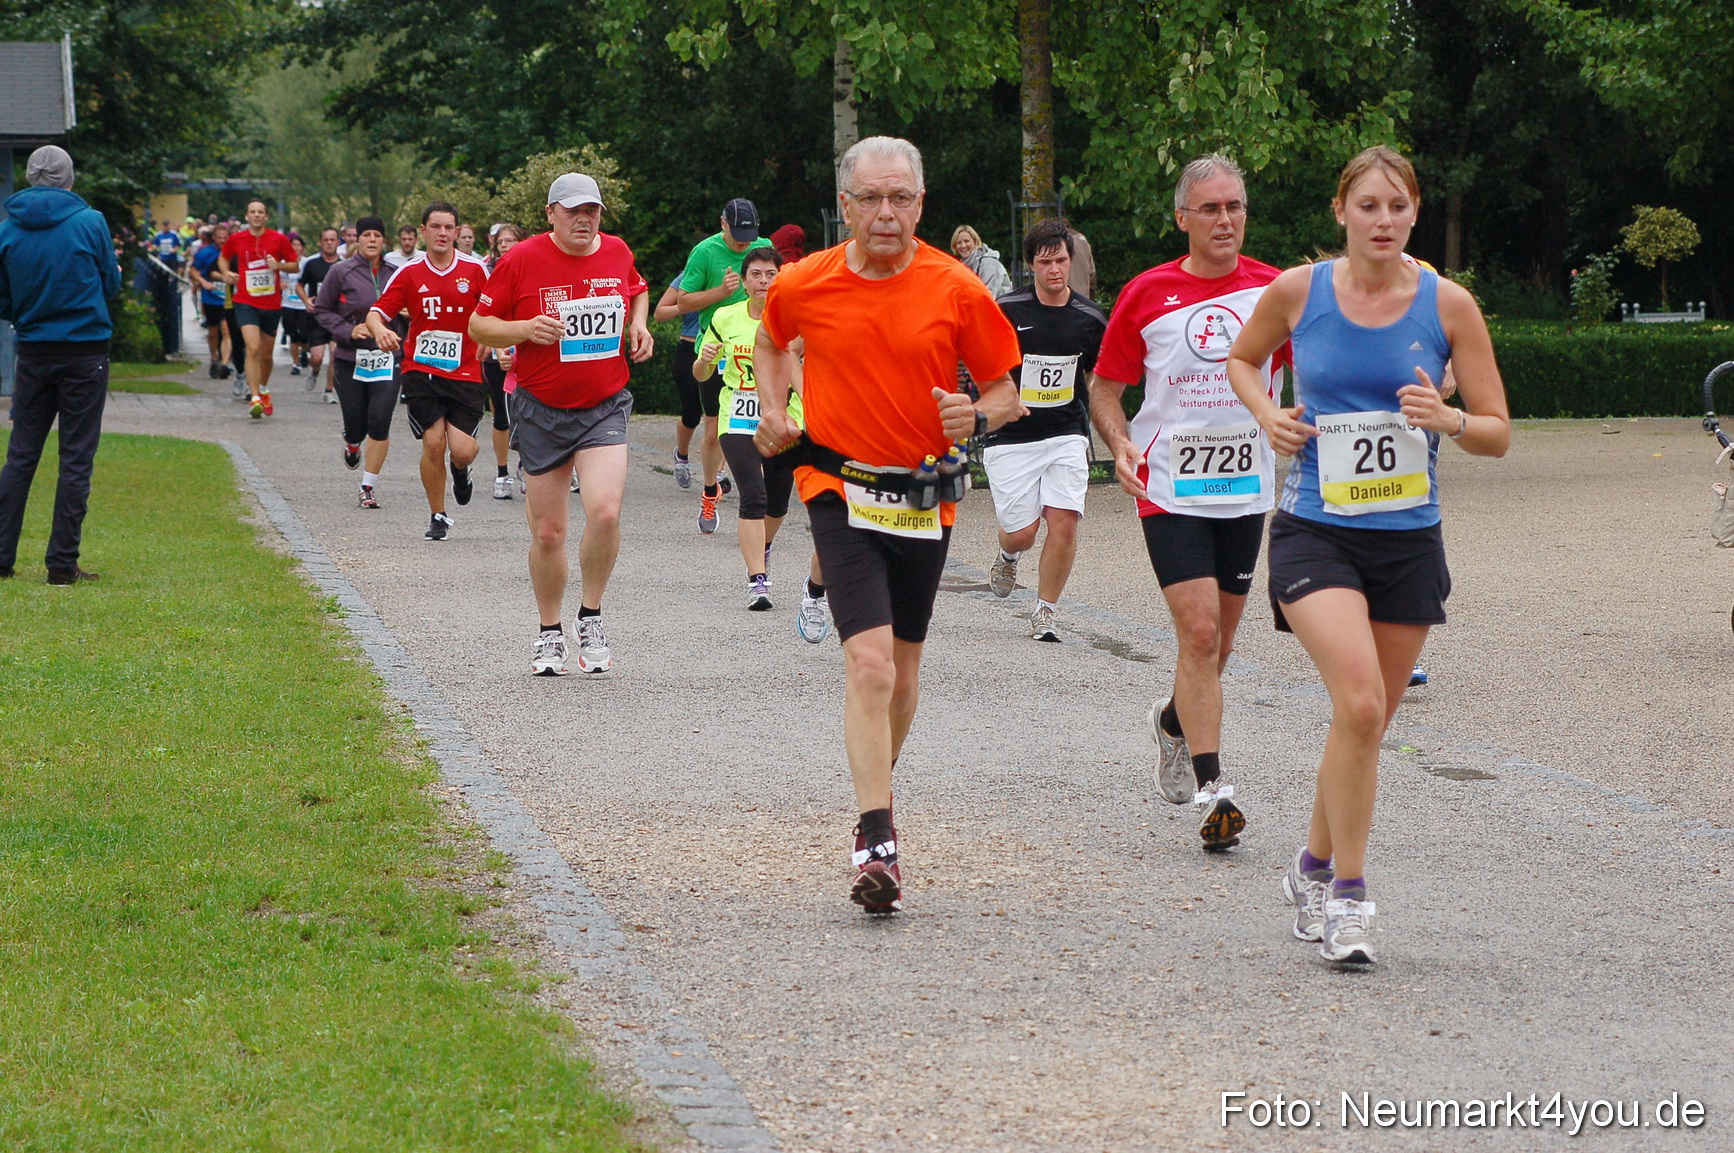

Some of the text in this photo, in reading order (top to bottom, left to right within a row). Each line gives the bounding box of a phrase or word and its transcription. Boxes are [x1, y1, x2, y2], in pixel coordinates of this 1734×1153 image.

[251, 275, 269, 286] 209
[583, 303, 613, 311] Neumarkt
[566, 311, 617, 337] 3021
[420, 339, 457, 358] 2348
[582, 342, 605, 352] Franz
[1040, 368, 1063, 388] 62
[1168, 374, 1209, 387] LAUFEN
[1037, 391, 1061, 401] Tobias
[1191, 387, 1211, 396] Heck
[1319, 422, 1407, 434] PARTL Neumarkt
[1172, 432, 1247, 443] PARTL Neumarkt
[1179, 443, 1253, 475] 2728
[1353, 435, 1396, 475] 26
[1202, 481, 1234, 494] Josef
[1350, 482, 1403, 500] Daniela
[853, 505, 934, 530] Heinz- Jürgen
